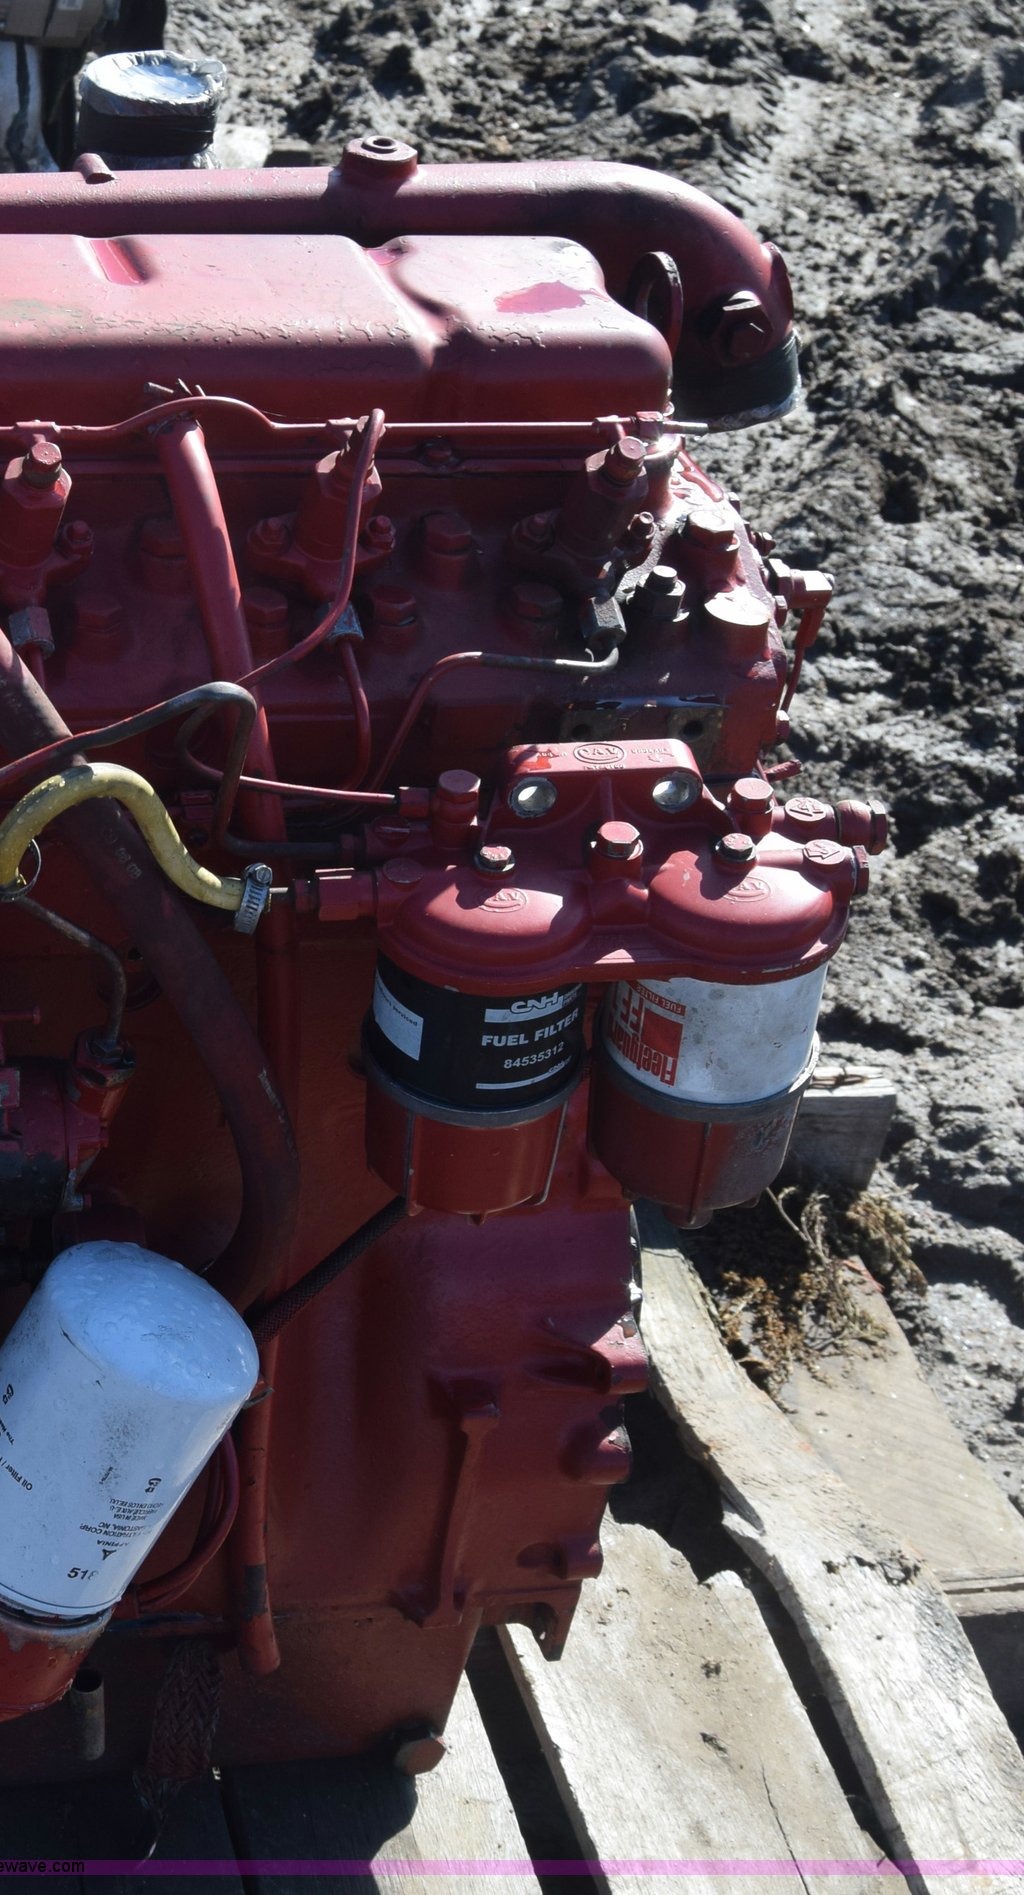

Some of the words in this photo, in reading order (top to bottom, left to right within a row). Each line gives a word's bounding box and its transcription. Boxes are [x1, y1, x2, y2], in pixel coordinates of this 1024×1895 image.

[510, 992, 559, 1014] CNH
[636, 986, 660, 1004] FILTER
[662, 999, 681, 1014] FUEL
[481, 1033, 529, 1047] FUEL
[534, 1008, 579, 1041] FILTER
[503, 1041, 564, 1069] 84535312
[6, 1464, 23, 1483] Filter
[21, 1480, 33, 1491] Oil
[80, 1523, 103, 1535] CORP.
[98, 1521, 111, 1530] NC
